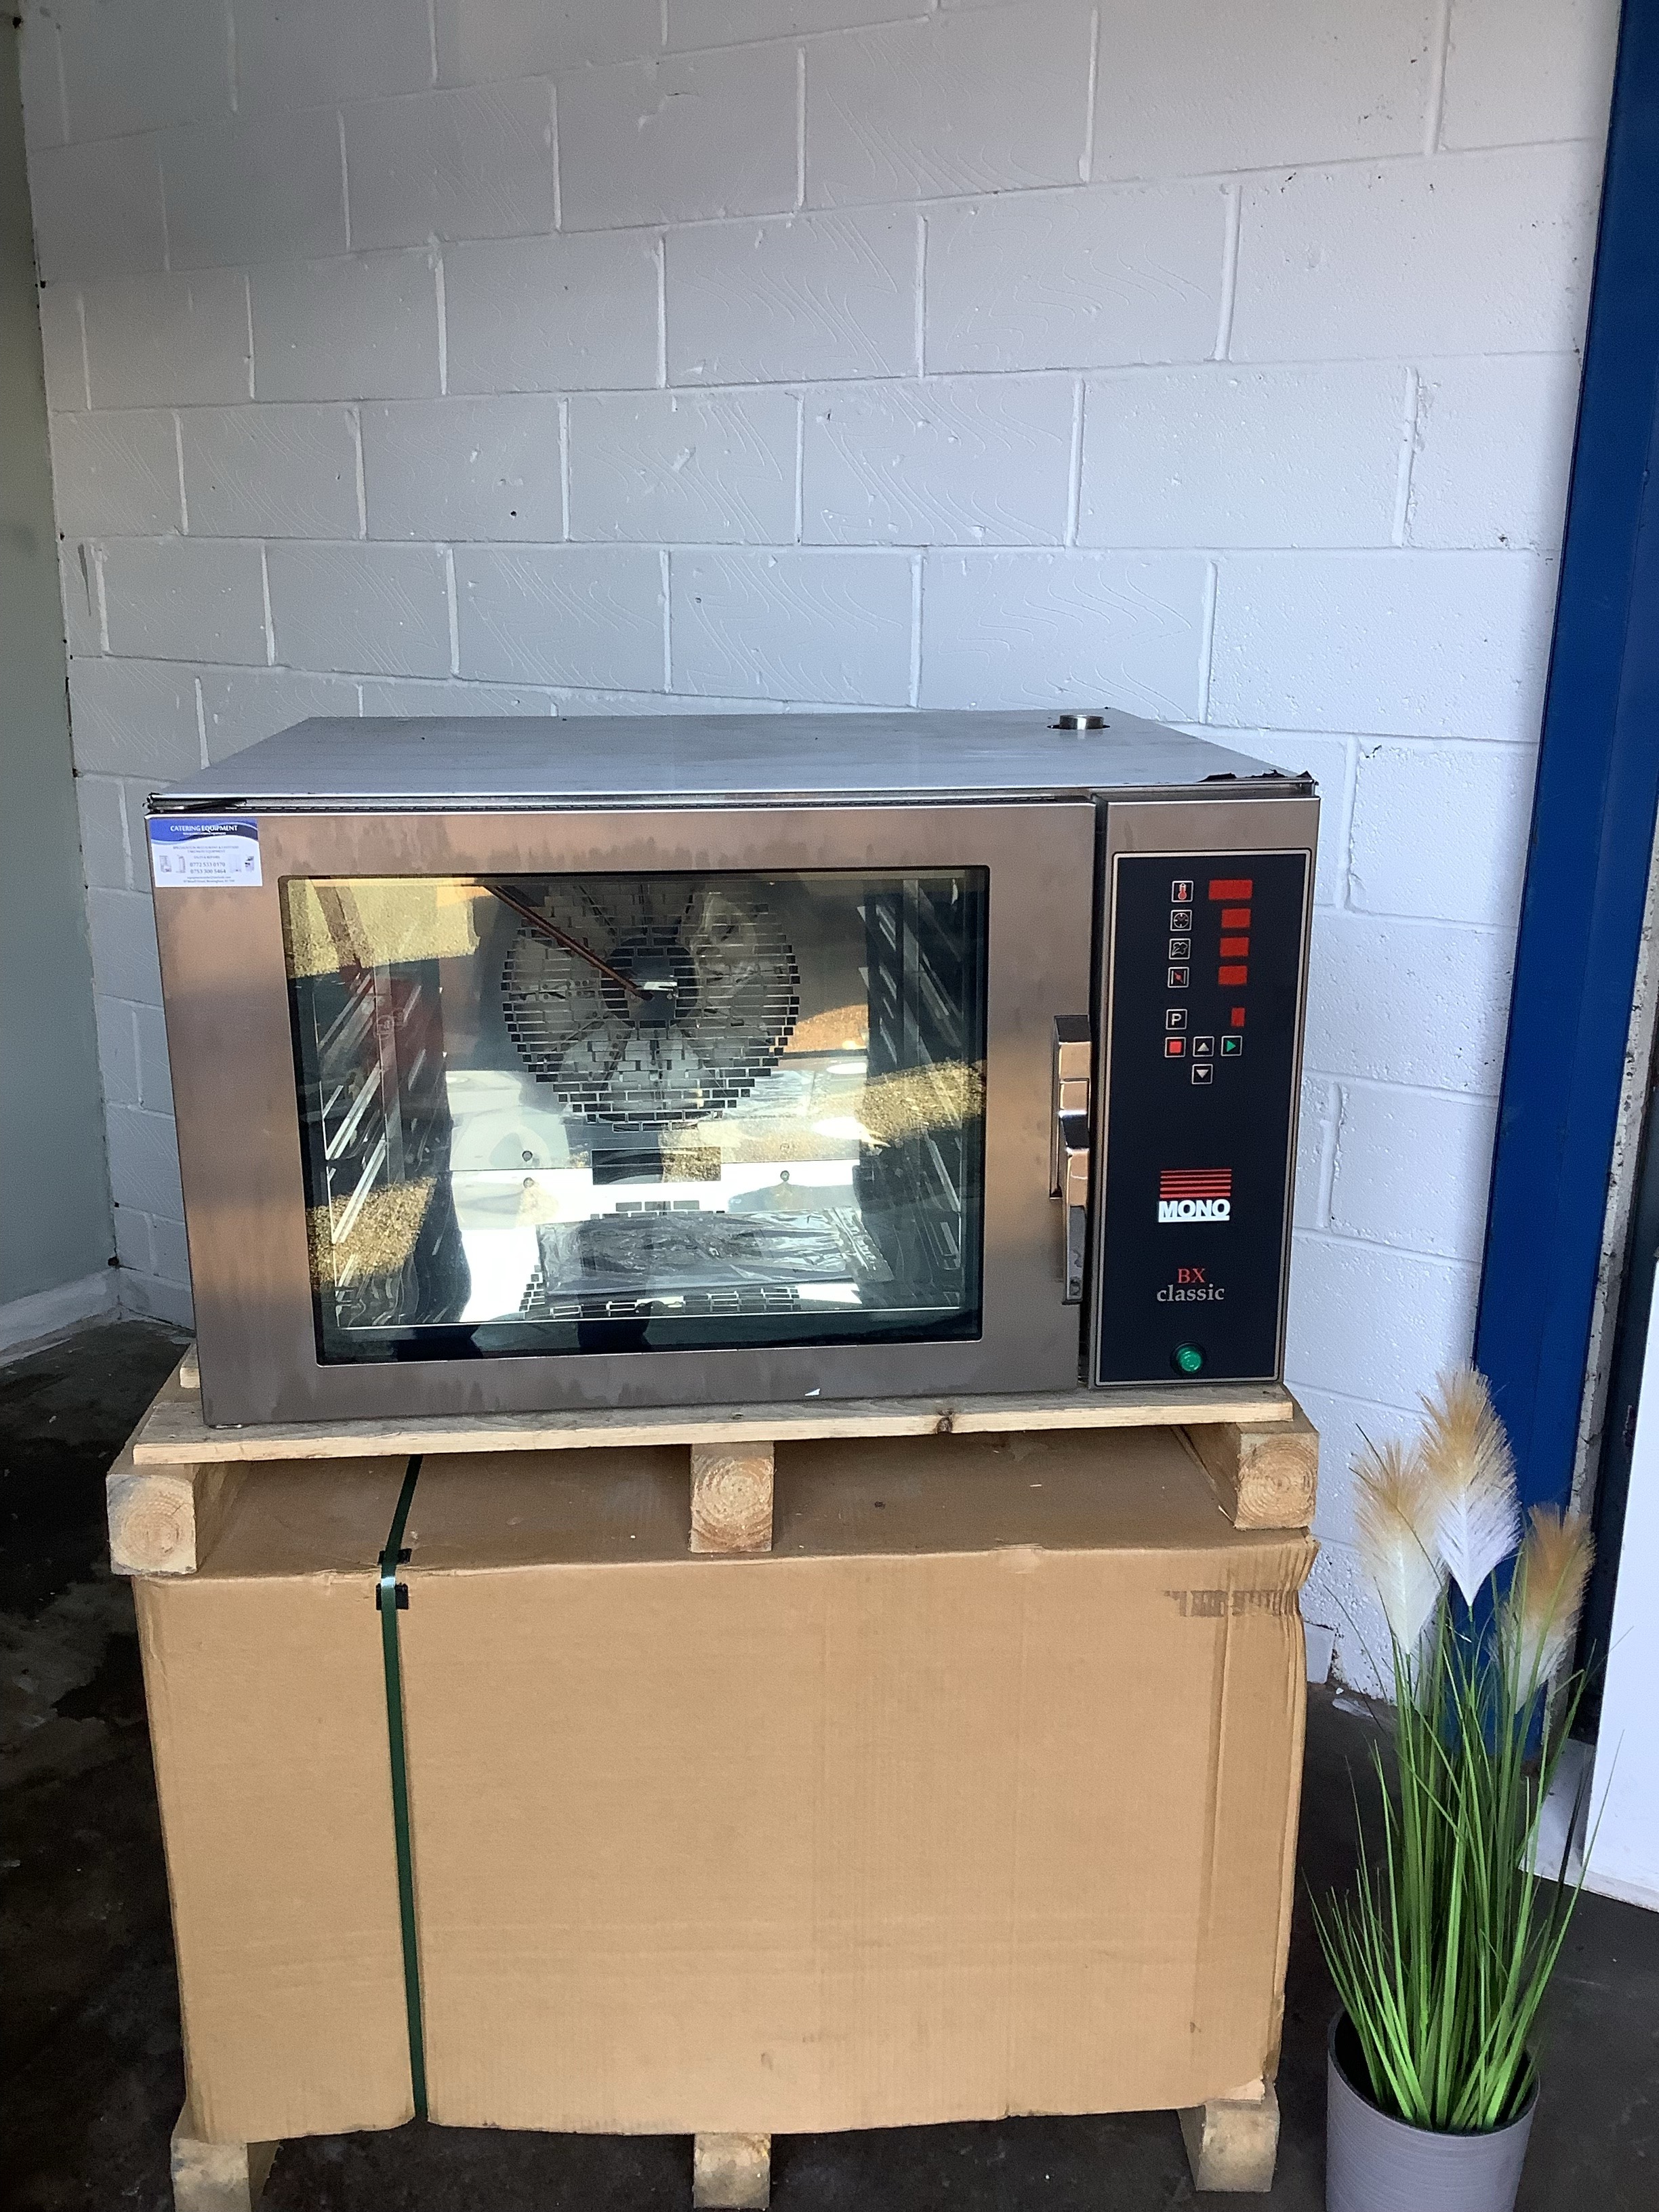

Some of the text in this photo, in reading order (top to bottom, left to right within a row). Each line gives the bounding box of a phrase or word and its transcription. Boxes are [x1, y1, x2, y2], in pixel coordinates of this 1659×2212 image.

[1172, 1013, 1181, 1025] P
[1158, 1199, 1231, 1222] MONO
[1178, 1268, 1206, 1283] BX
[1157, 1284, 1225, 1301] classic
